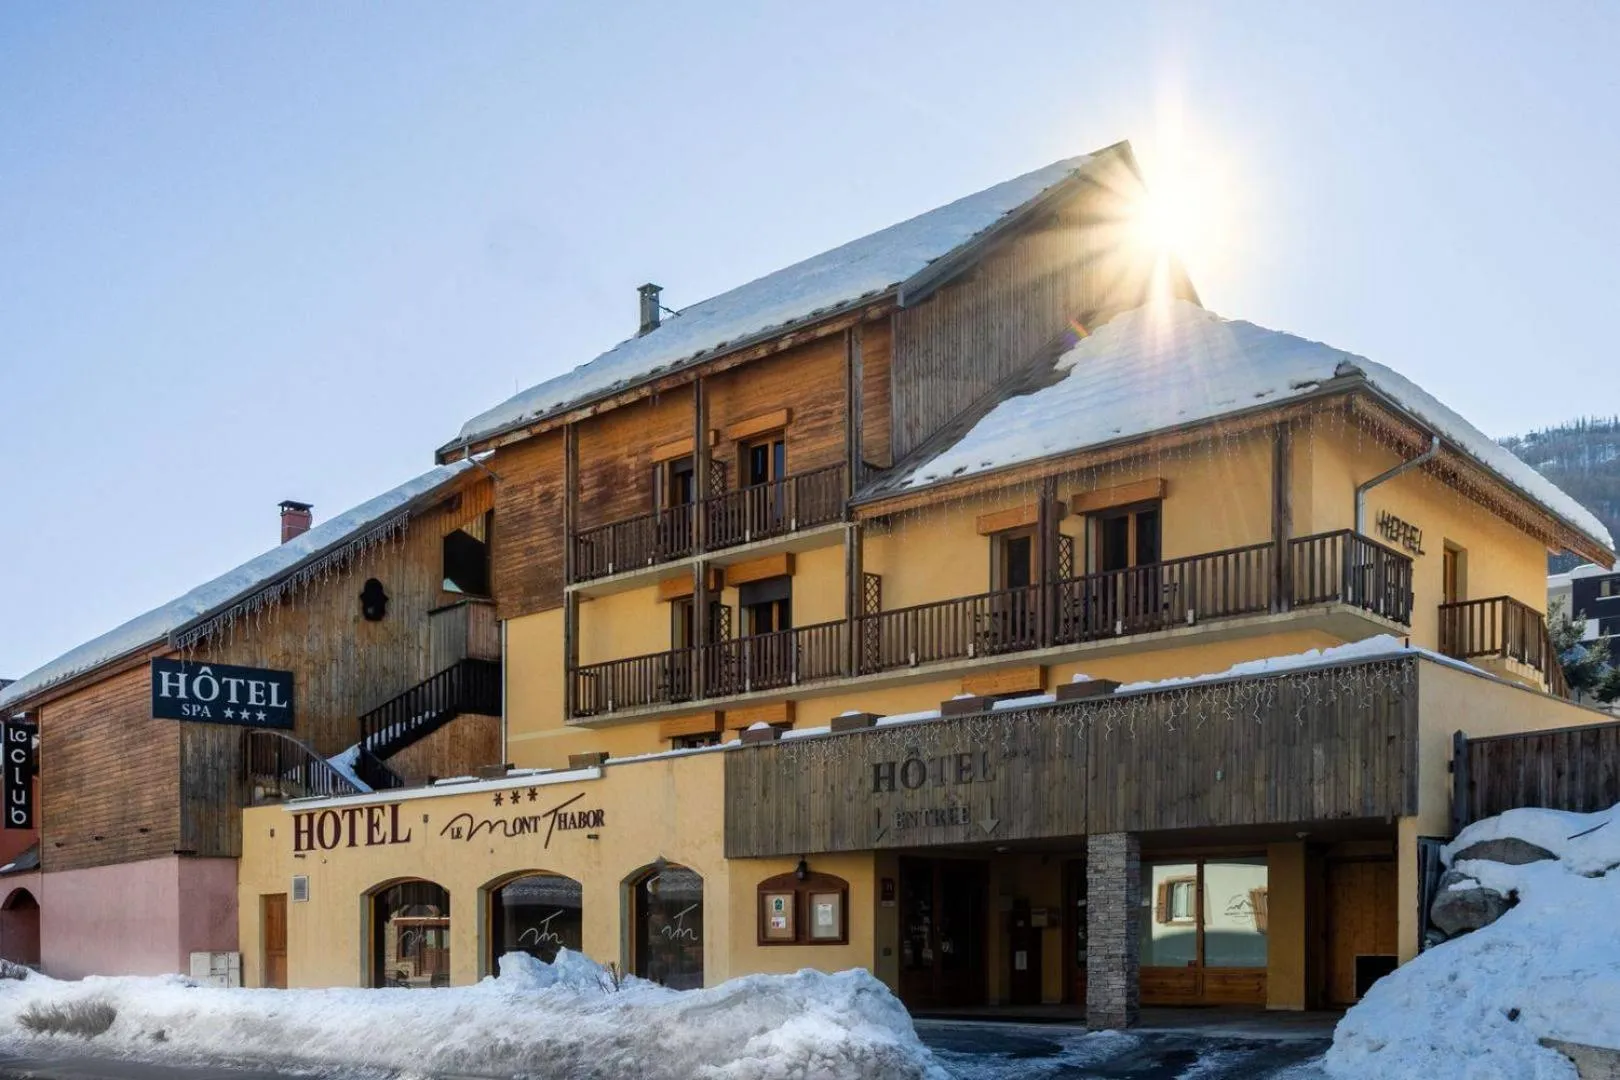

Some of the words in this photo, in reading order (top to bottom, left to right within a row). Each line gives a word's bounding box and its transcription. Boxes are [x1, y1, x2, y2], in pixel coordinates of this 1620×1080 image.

[1378, 509, 1425, 555] HOTEL
[159, 666, 288, 709] HÔTEL
[181, 703, 212, 718] SPA
[872, 746, 997, 793] HÔTEL
[292, 803, 412, 852] HOTEL
[543, 792, 606, 849] THABOR
